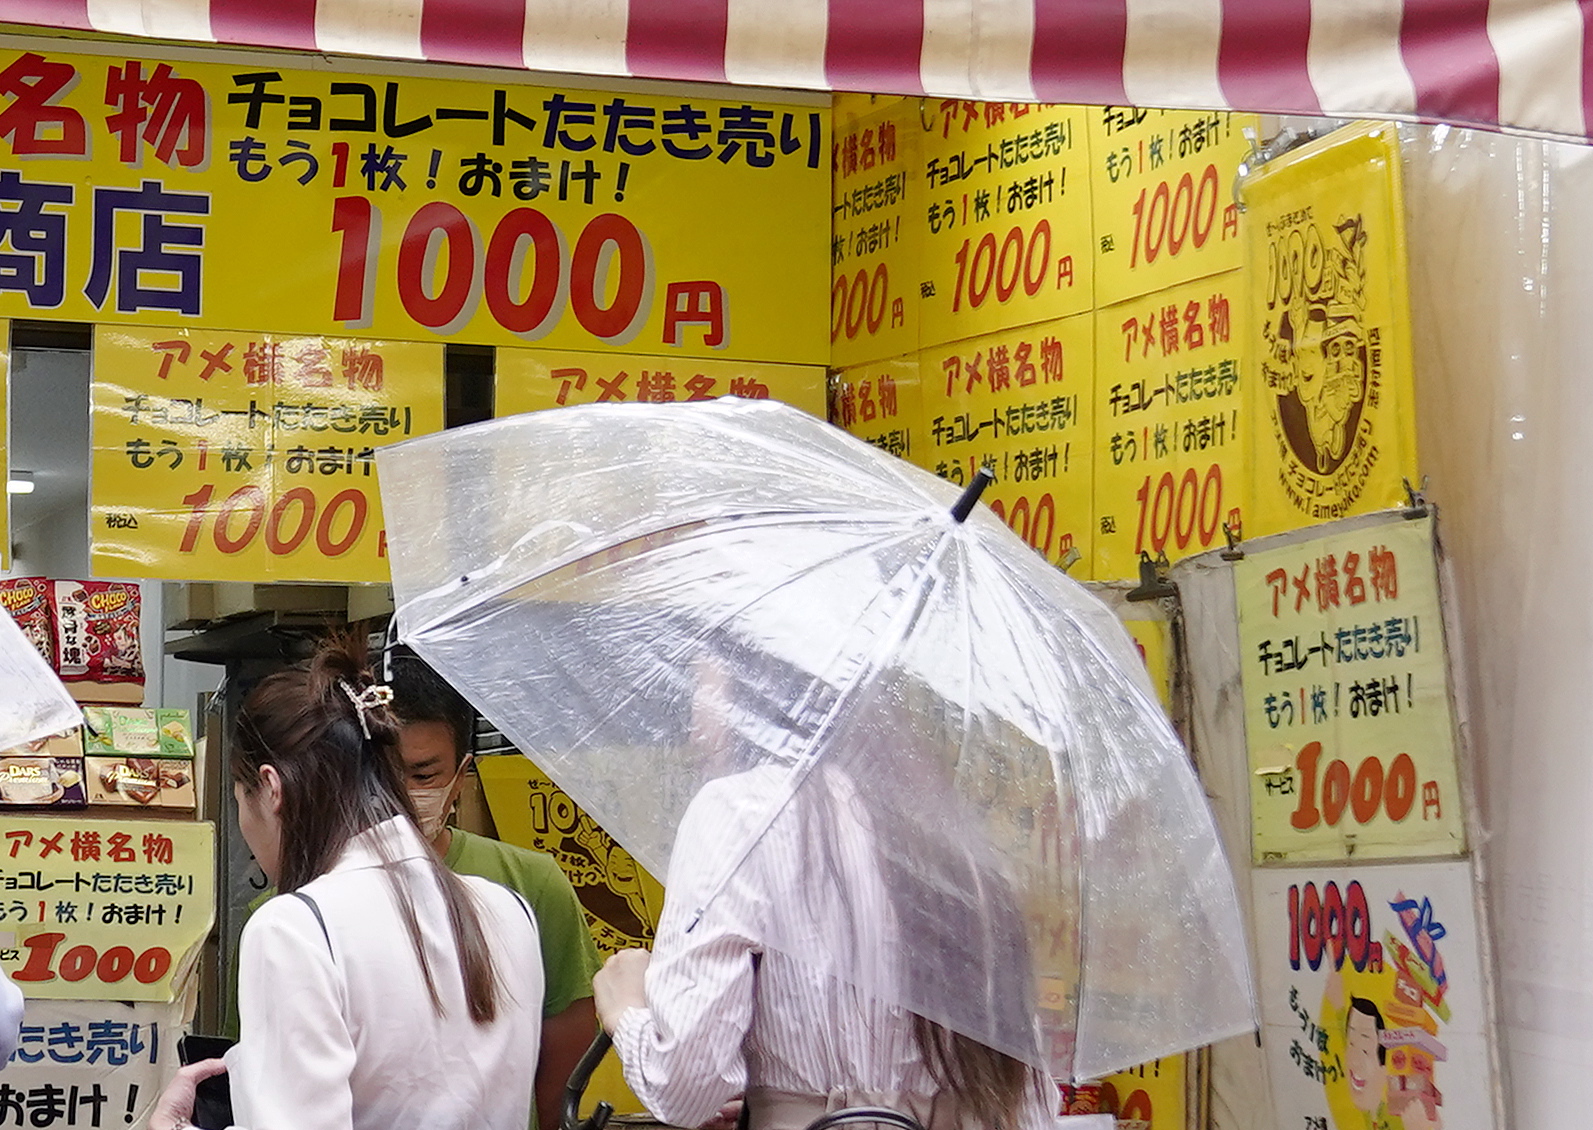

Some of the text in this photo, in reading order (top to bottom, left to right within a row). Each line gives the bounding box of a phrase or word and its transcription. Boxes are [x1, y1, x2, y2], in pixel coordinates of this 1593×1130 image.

[226, 70, 823, 170] チョコレートたたき売り
[926, 118, 1072, 190] チョコレートたたき売り
[1129, 163, 1239, 270] 1000円
[330, 194, 731, 350] 1000円
[952, 218, 1074, 313] 1000円
[1121, 292, 1231, 364] アメ横名物
[151, 340, 385, 392] アメ横名物
[942, 335, 1063, 399] アメ横名物
[1108, 358, 1242, 417] チョコレートたたき売り
[931, 393, 1078, 447] チョコレートたたき売り
[91, 591, 128, 610] CHOCO
[1265, 545, 1399, 619] アメ横名物
[1257, 614, 1421, 677] チョコレートたたき売り
[8, 764, 42, 777] DARS
[1289, 740, 1443, 832] 1000円
[5, 830, 174, 865] アメ横名物
[11, 932, 172, 984] 1000
[1287, 879, 1384, 974] 1000円
